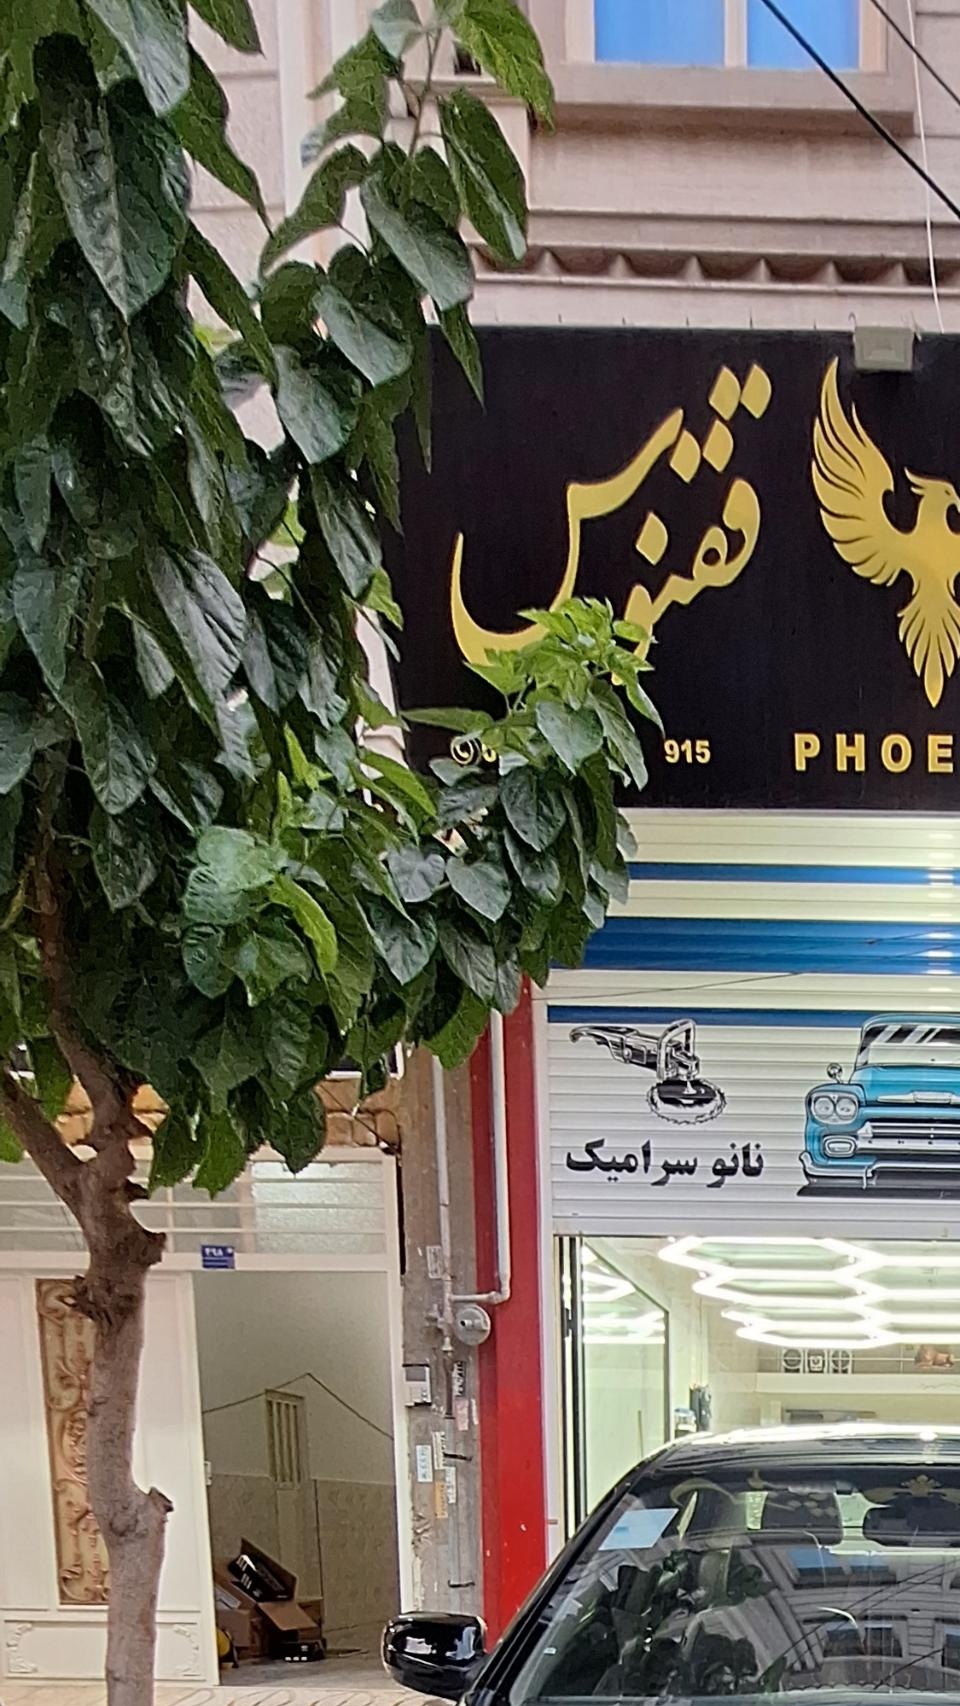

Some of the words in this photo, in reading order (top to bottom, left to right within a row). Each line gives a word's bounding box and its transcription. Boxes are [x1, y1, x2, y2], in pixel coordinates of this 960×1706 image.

[663, 738, 711, 764] 915
[566, 1138, 698, 1186] سرامیک
[706, 1142, 764, 1188] نانو
